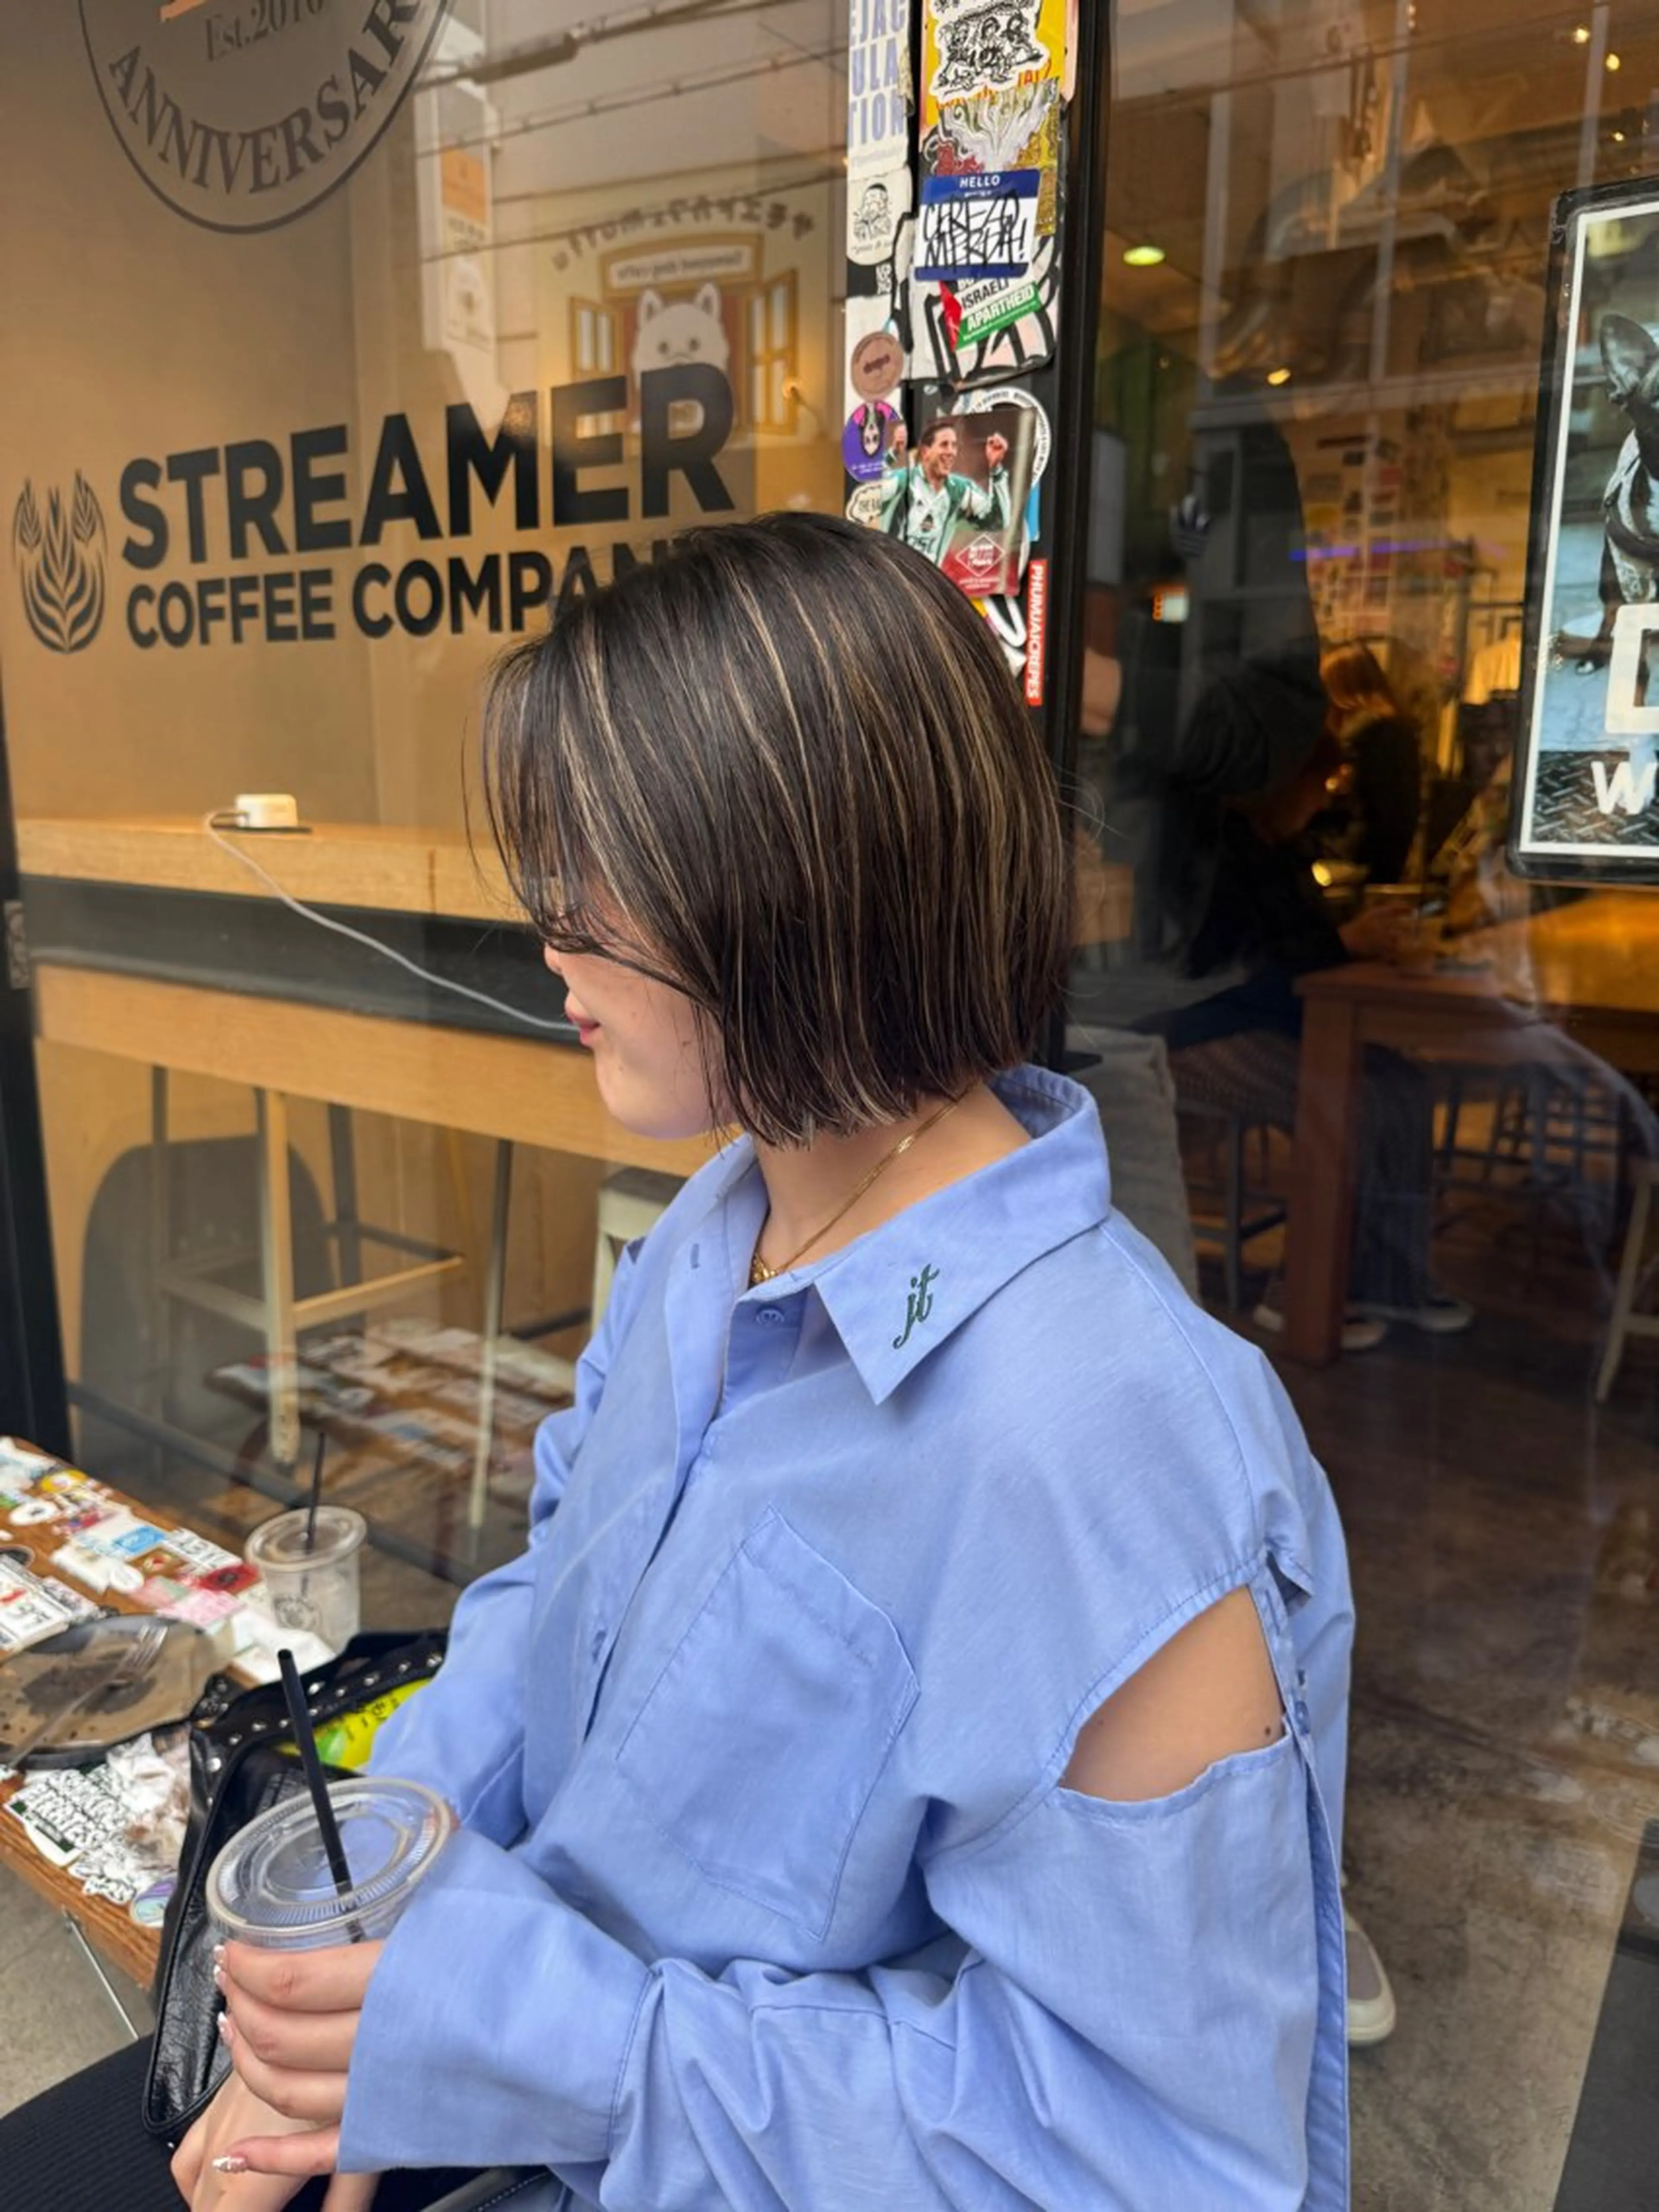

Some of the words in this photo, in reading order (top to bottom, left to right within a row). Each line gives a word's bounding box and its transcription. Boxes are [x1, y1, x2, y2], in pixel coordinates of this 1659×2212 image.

[959, 174, 1001, 188] HELLO
[966, 284, 1033, 332] APARTHEID
[120, 362, 736, 570] STREAMER
[126, 569, 336, 649] COFFEE
